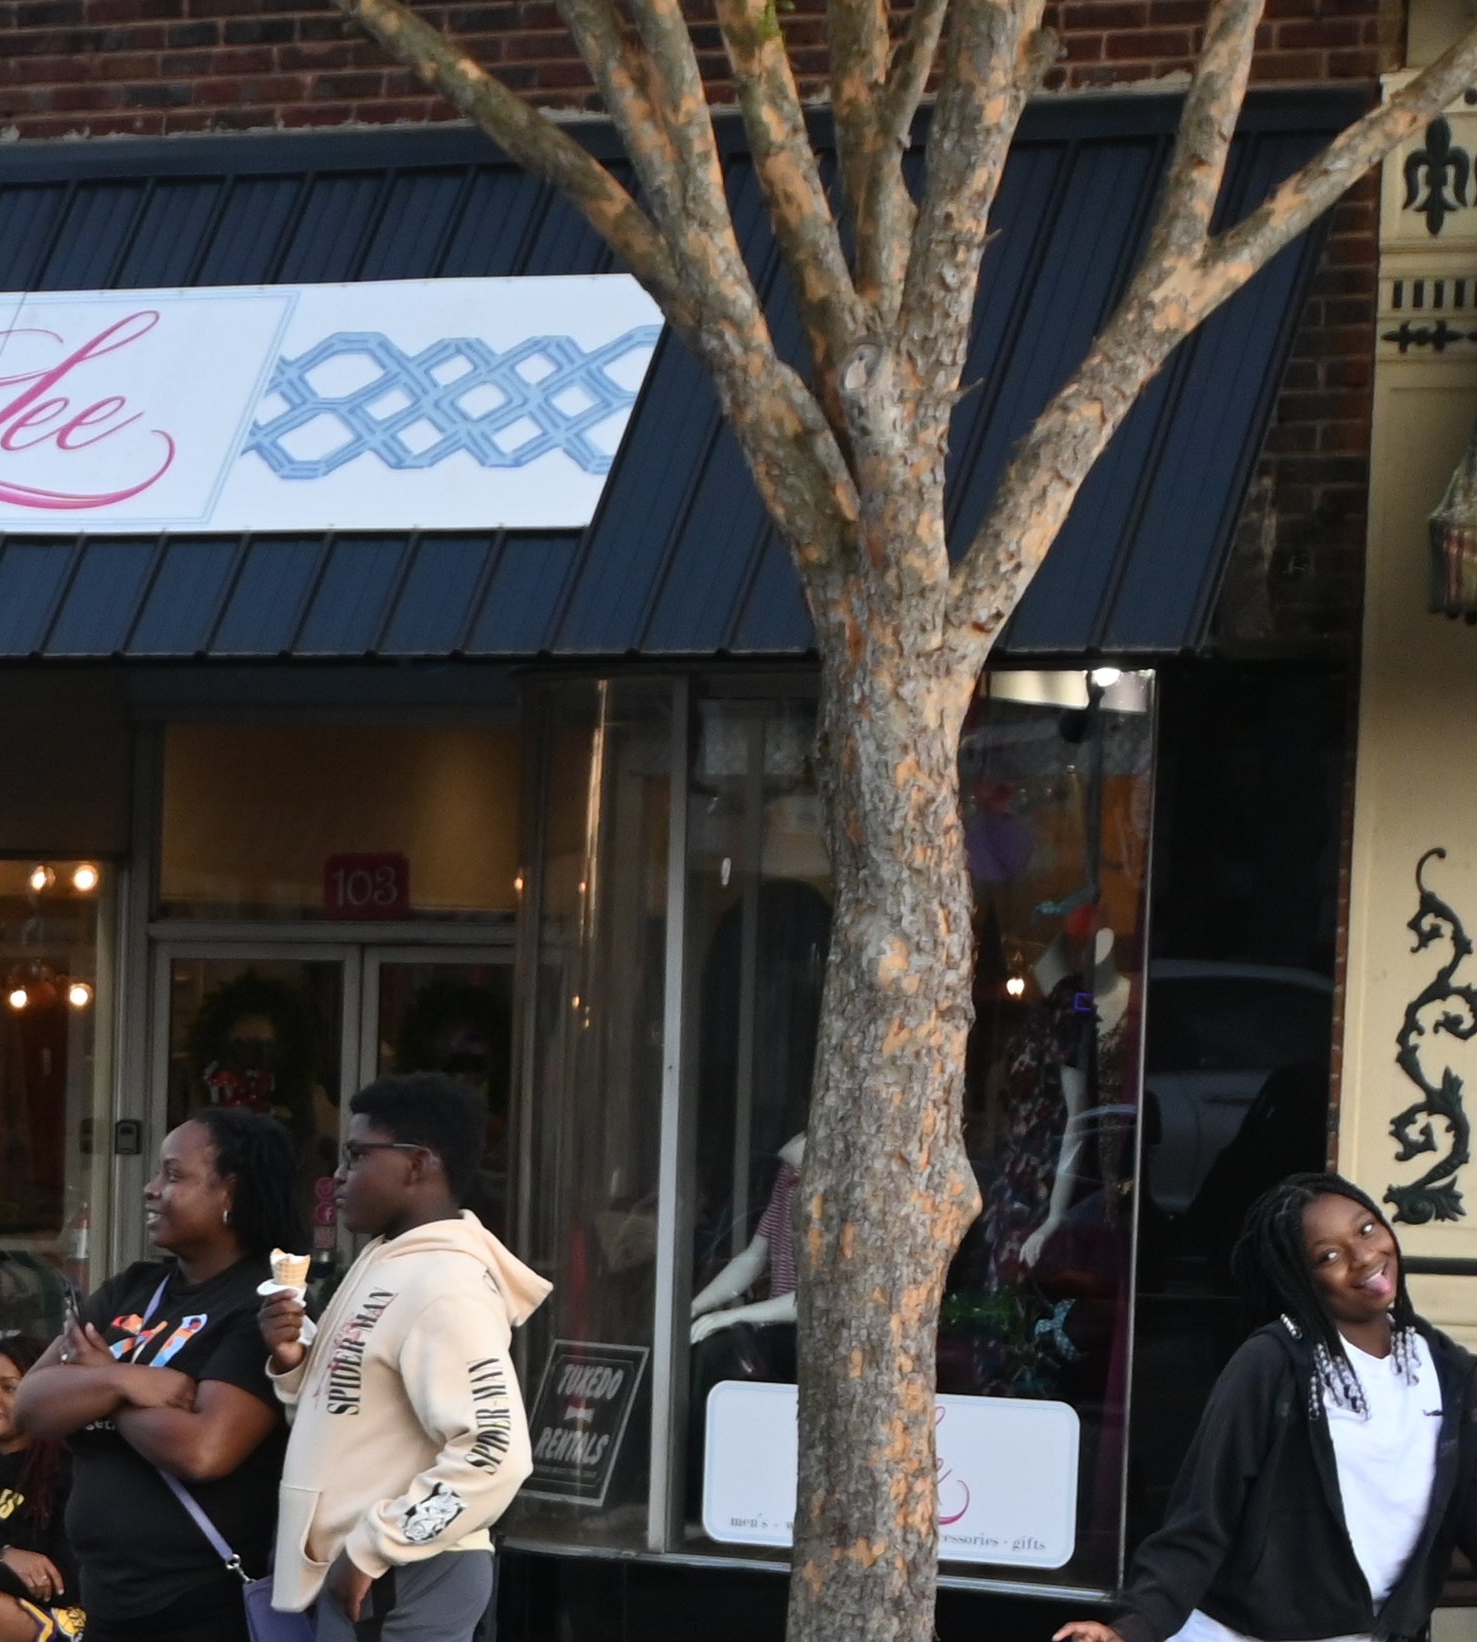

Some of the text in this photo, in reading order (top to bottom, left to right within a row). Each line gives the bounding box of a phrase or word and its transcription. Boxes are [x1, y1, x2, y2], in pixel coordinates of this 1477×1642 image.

[333, 866, 398, 909] 103
[556, 1363, 625, 1401] TUXEDO
[534, 1426, 611, 1466] RENTALS
[731, 1512, 768, 1529] men's
[1012, 1535, 1046, 1552] gifts
